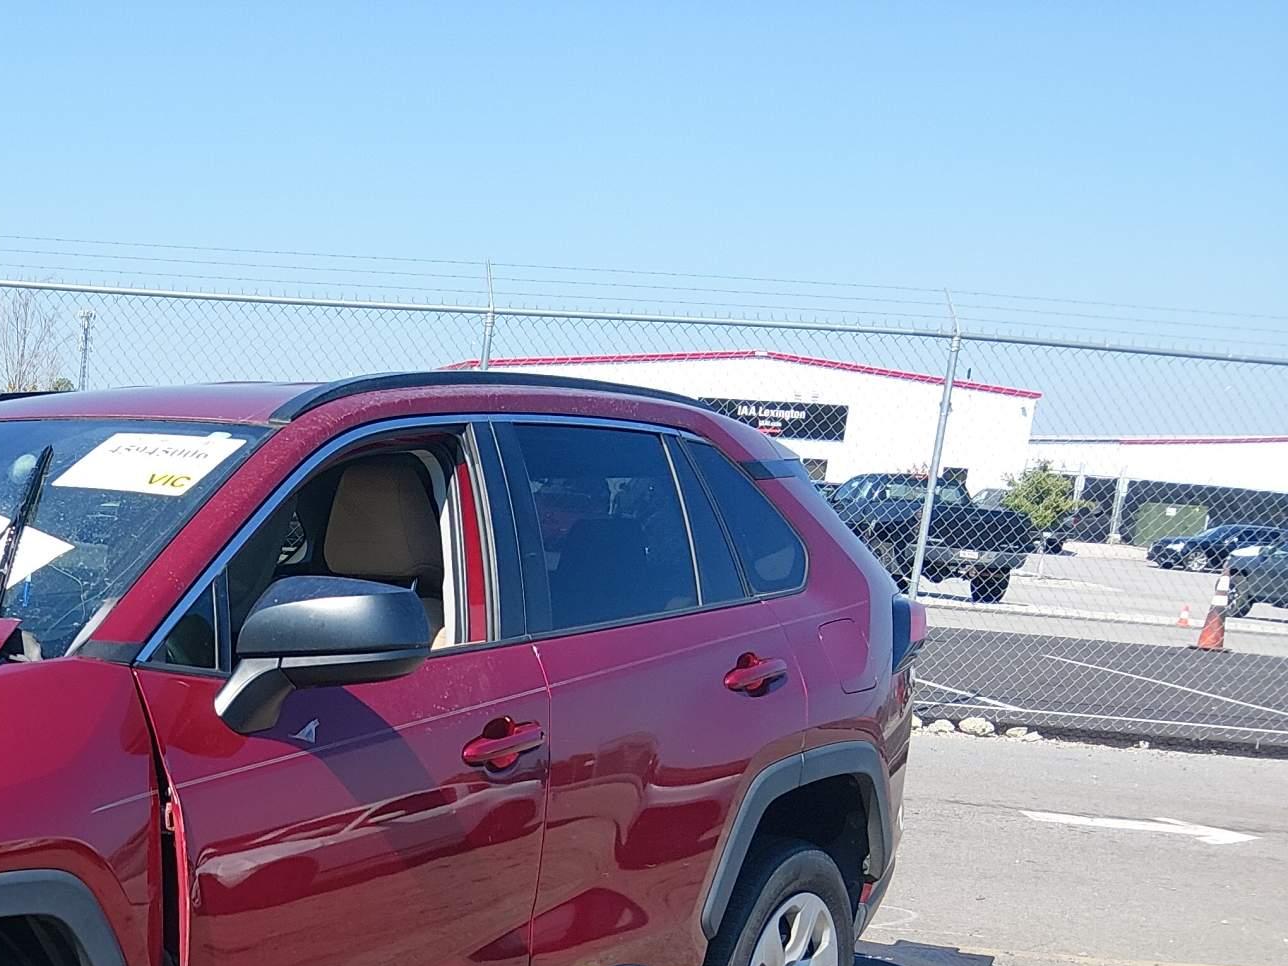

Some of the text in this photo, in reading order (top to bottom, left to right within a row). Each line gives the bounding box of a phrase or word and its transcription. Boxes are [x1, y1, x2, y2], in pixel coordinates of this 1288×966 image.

[737, 405, 806, 420] IAA Lexington
[148, 472, 192, 488] VIC
